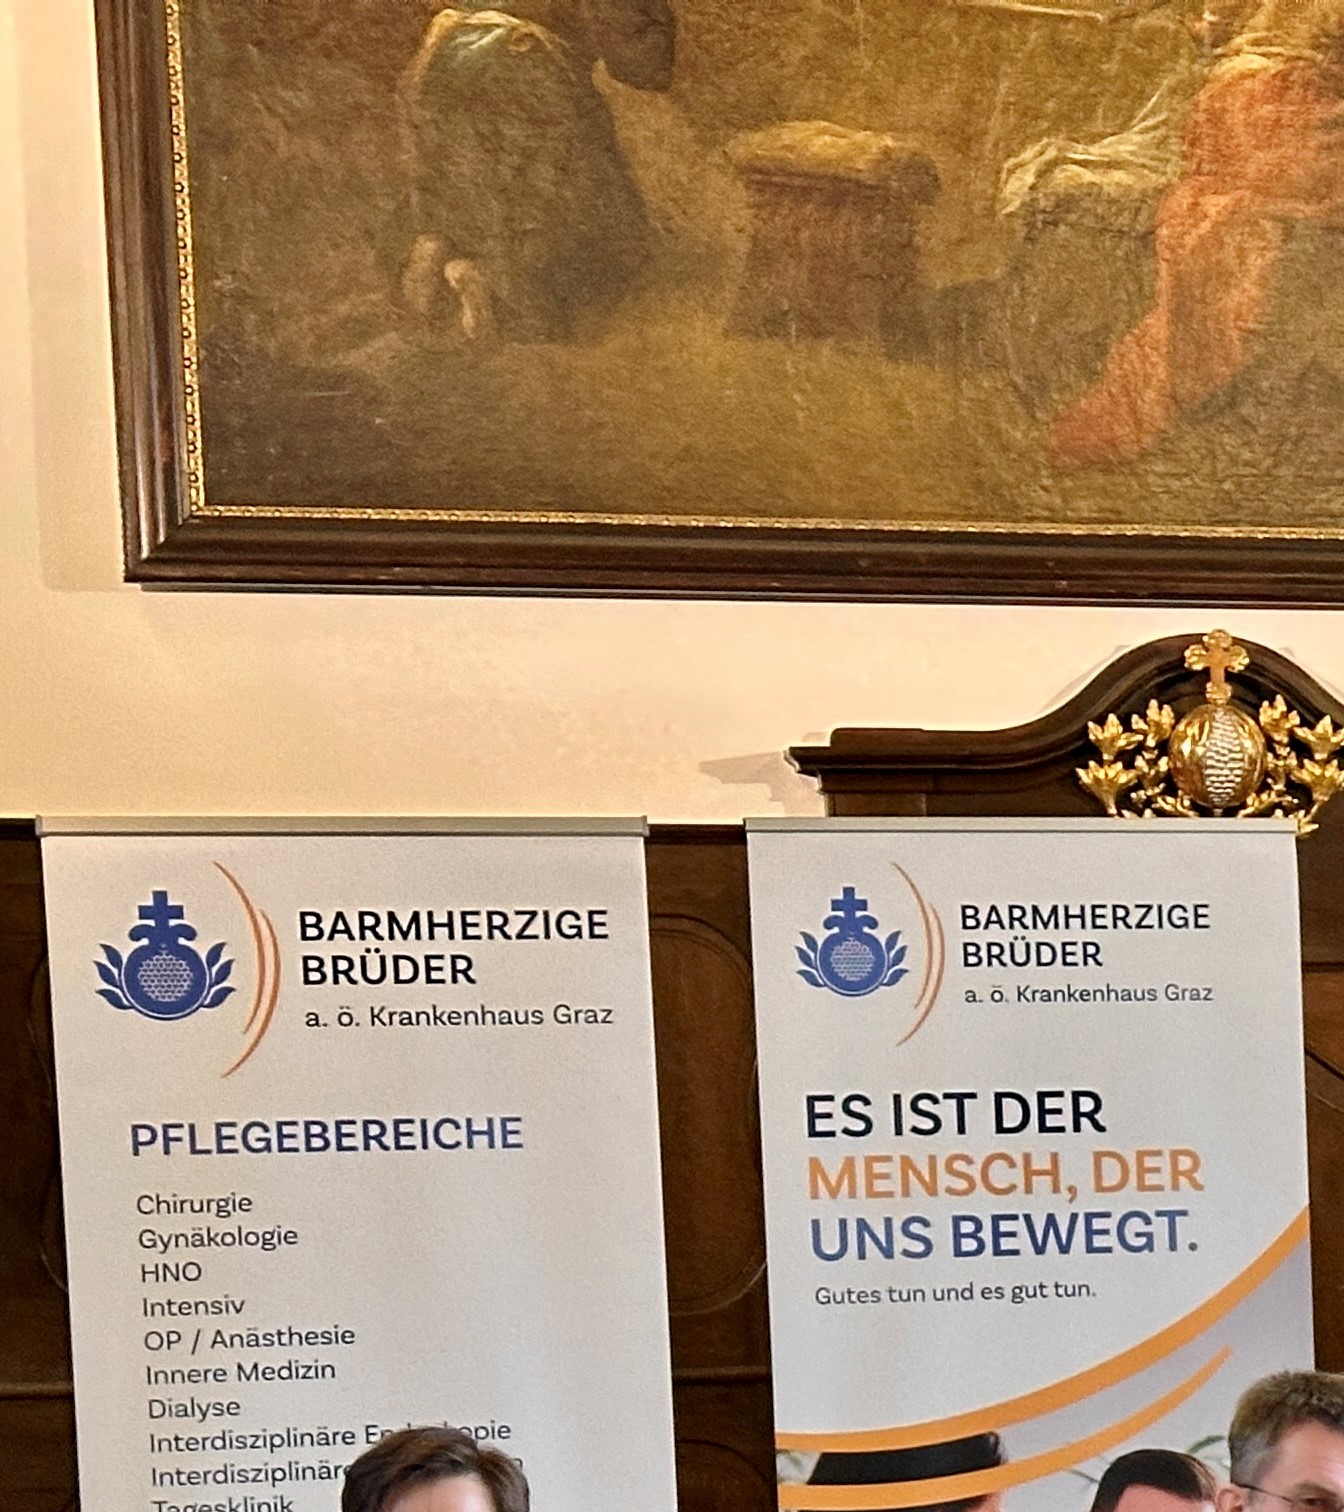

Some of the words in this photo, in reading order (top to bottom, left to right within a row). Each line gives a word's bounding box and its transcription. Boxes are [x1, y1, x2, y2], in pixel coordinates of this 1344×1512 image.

[300, 910, 608, 941] BARMHERZIGE
[961, 904, 1210, 930] BARMHERZIGE
[963, 936, 1103, 967] BRÜDER
[302, 948, 476, 985] BRÜDER
[965, 990, 983, 1003] a.
[991, 986, 1008, 1003] ö.
[1017, 984, 1157, 1002] Krankenhaus
[1165, 984, 1213, 1001] Graz
[306, 1012, 327, 1027] a.
[338, 1006, 360, 1027] ö.
[370, 1004, 544, 1026] Krankenhaus
[554, 1004, 613, 1024] Graz
[807, 1094, 873, 1138] ES
[893, 1092, 977, 1136] IST
[994, 1091, 1106, 1134] DER
[132, 1117, 523, 1156] PFLEGEBEREICHE
[809, 1152, 1077, 1204] MENSCH,
[1093, 1149, 1204, 1193] DER
[137, 1192, 252, 1218] Chirurgie
[139, 1225, 297, 1254] Gynäkologie
[811, 1216, 933, 1261] UNS
[952, 1210, 1197, 1257] BEWEGT.
[142, 1262, 201, 1283] HNO
[143, 1295, 245, 1316] Intensiv
[816, 1287, 881, 1305] Gutes
[888, 1287, 925, 1303] tun
[933, 1282, 973, 1301] und
[981, 1287, 1004, 1300] es
[1011, 1282, 1048, 1304] gut
[1054, 1282, 1095, 1297] tun.
[145, 1331, 181, 1350] OP
[191, 1329, 201, 1355] /
[211, 1325, 355, 1349] Anästhesie
[147, 1366, 227, 1385] Innere
[237, 1359, 335, 1381] Medizin
[149, 1397, 240, 1423] Dialyse
[150, 1427, 355, 1453] Interdisziplinäre
[365, 1420, 511, 1445] Enopie
